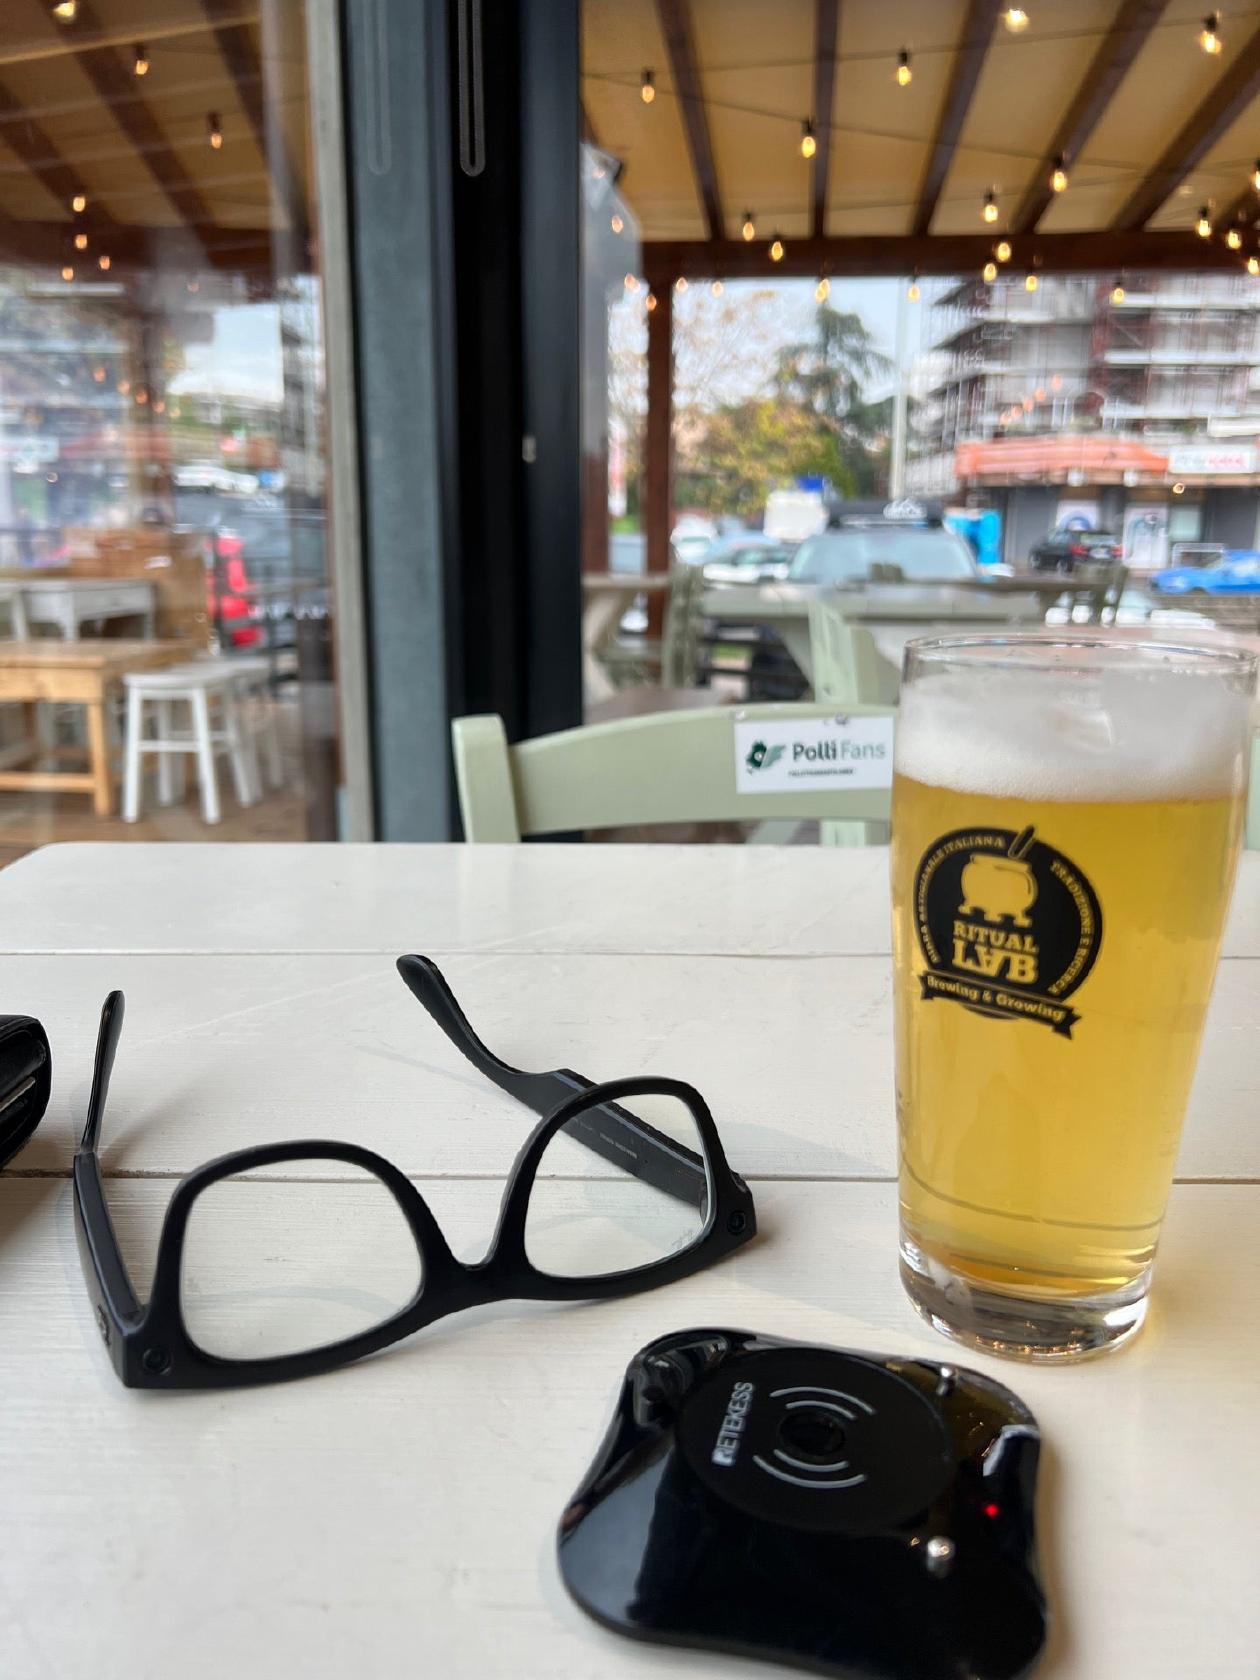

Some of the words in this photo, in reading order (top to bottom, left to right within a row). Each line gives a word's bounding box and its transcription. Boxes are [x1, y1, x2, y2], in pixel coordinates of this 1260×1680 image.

[944, 835, 1006, 854] ITALIANA
[1050, 859, 1092, 935] TRADIZIONE
[953, 921, 1037, 953] RITUAL
[1079, 937, 1091, 946] E
[1047, 947, 1088, 996] RICERCA
[927, 975, 979, 1001] Brewing
[982, 990, 993, 1002] &
[996, 994, 1065, 1021] Growing
[711, 1382, 754, 1466] RETEKESS
